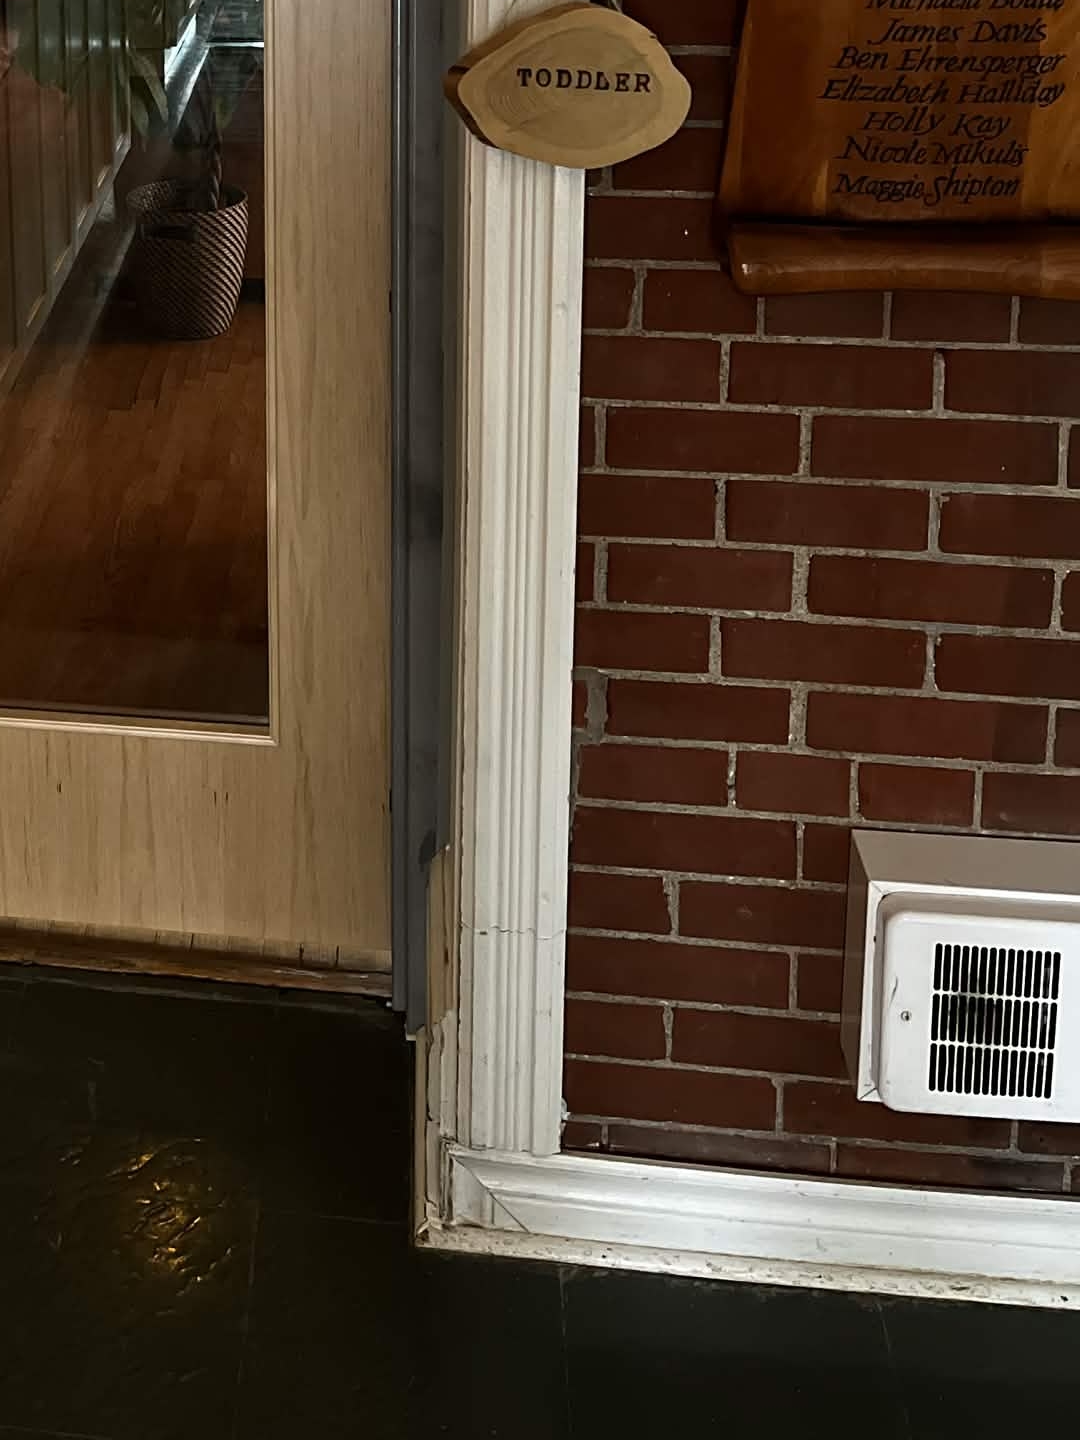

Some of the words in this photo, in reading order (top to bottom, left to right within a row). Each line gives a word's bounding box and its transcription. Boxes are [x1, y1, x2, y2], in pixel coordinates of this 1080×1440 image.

[868, 17, 964, 45] James
[968, 17, 1048, 43] Davis
[829, 46, 889, 72] Ben
[896, 46, 1067, 82] Ehrensperger
[516, 68, 651, 93] TODDLER
[818, 75, 949, 104] Elizabeth
[956, 78, 1065, 107] Halliday
[861, 107, 947, 136] Holly
[949, 112, 1011, 140] Kay
[835, 136, 929, 165] Nicole
[830, 172, 924, 202] Maggie
[924, 167, 1021, 207] Shipton
